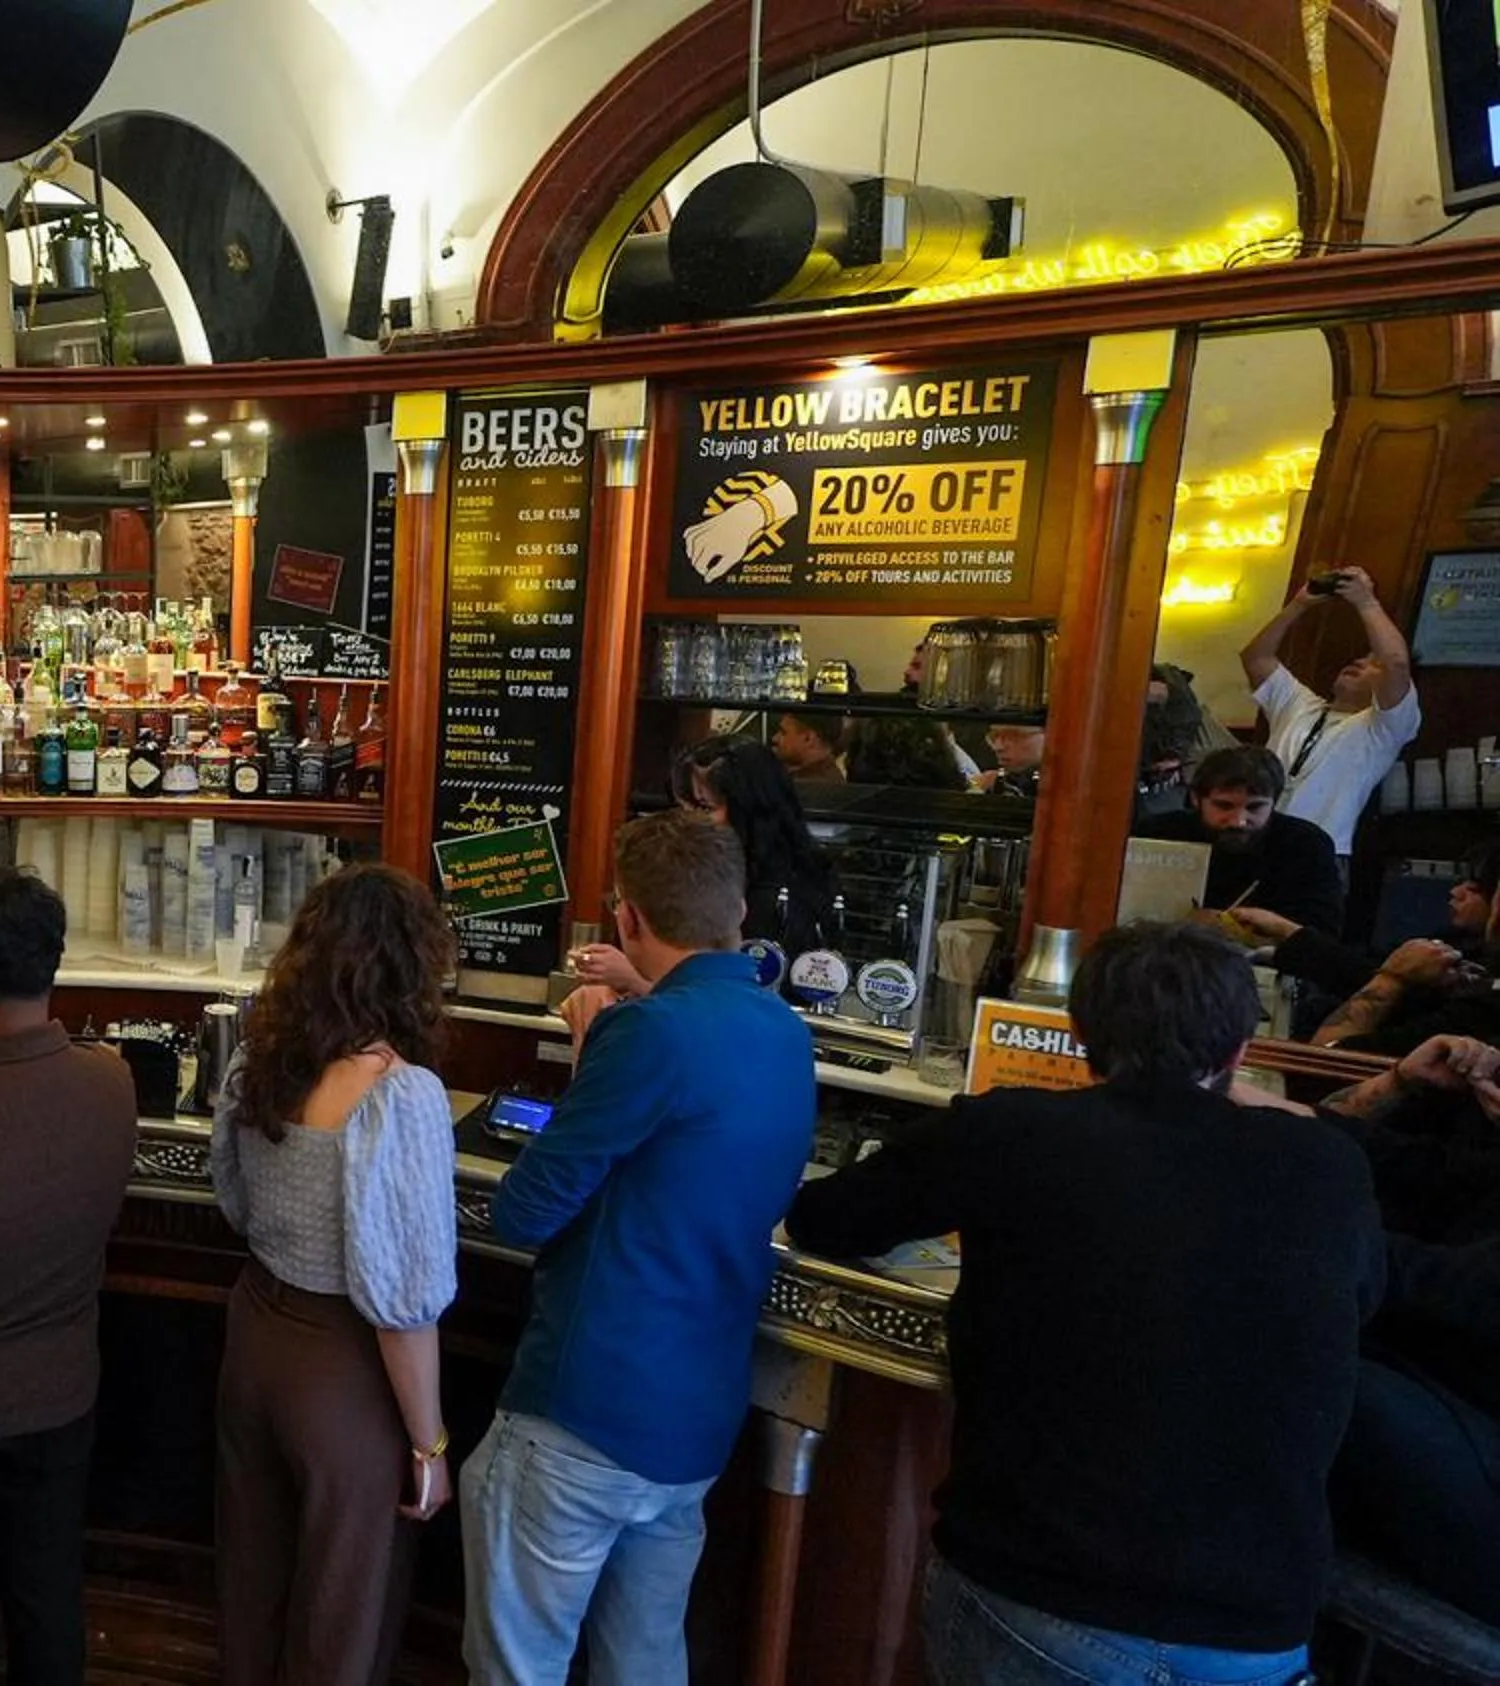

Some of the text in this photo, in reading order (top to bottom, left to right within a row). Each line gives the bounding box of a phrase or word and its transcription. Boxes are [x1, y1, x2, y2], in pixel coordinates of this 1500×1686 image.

[700, 376, 1030, 432] YELLOW BRACELET
[461, 405, 585, 454] BEERS
[700, 423, 1019, 460] Staying at YellowSquare gives you:
[460, 447, 585, 471] and ciders
[819, 469, 1016, 516] 20% OFF
[815, 517, 1012, 538] ANY ALCOHOLIC BEVERAGE
[817, 551, 1014, 566] PRIVILEGED ACCESS TO THE BAR
[815, 569, 1012, 584] 20% OFF TOURS AND ACTIVITIES
[448, 668, 501, 682] CARLSBERG
[505, 669, 553, 682] ELEPHANT
